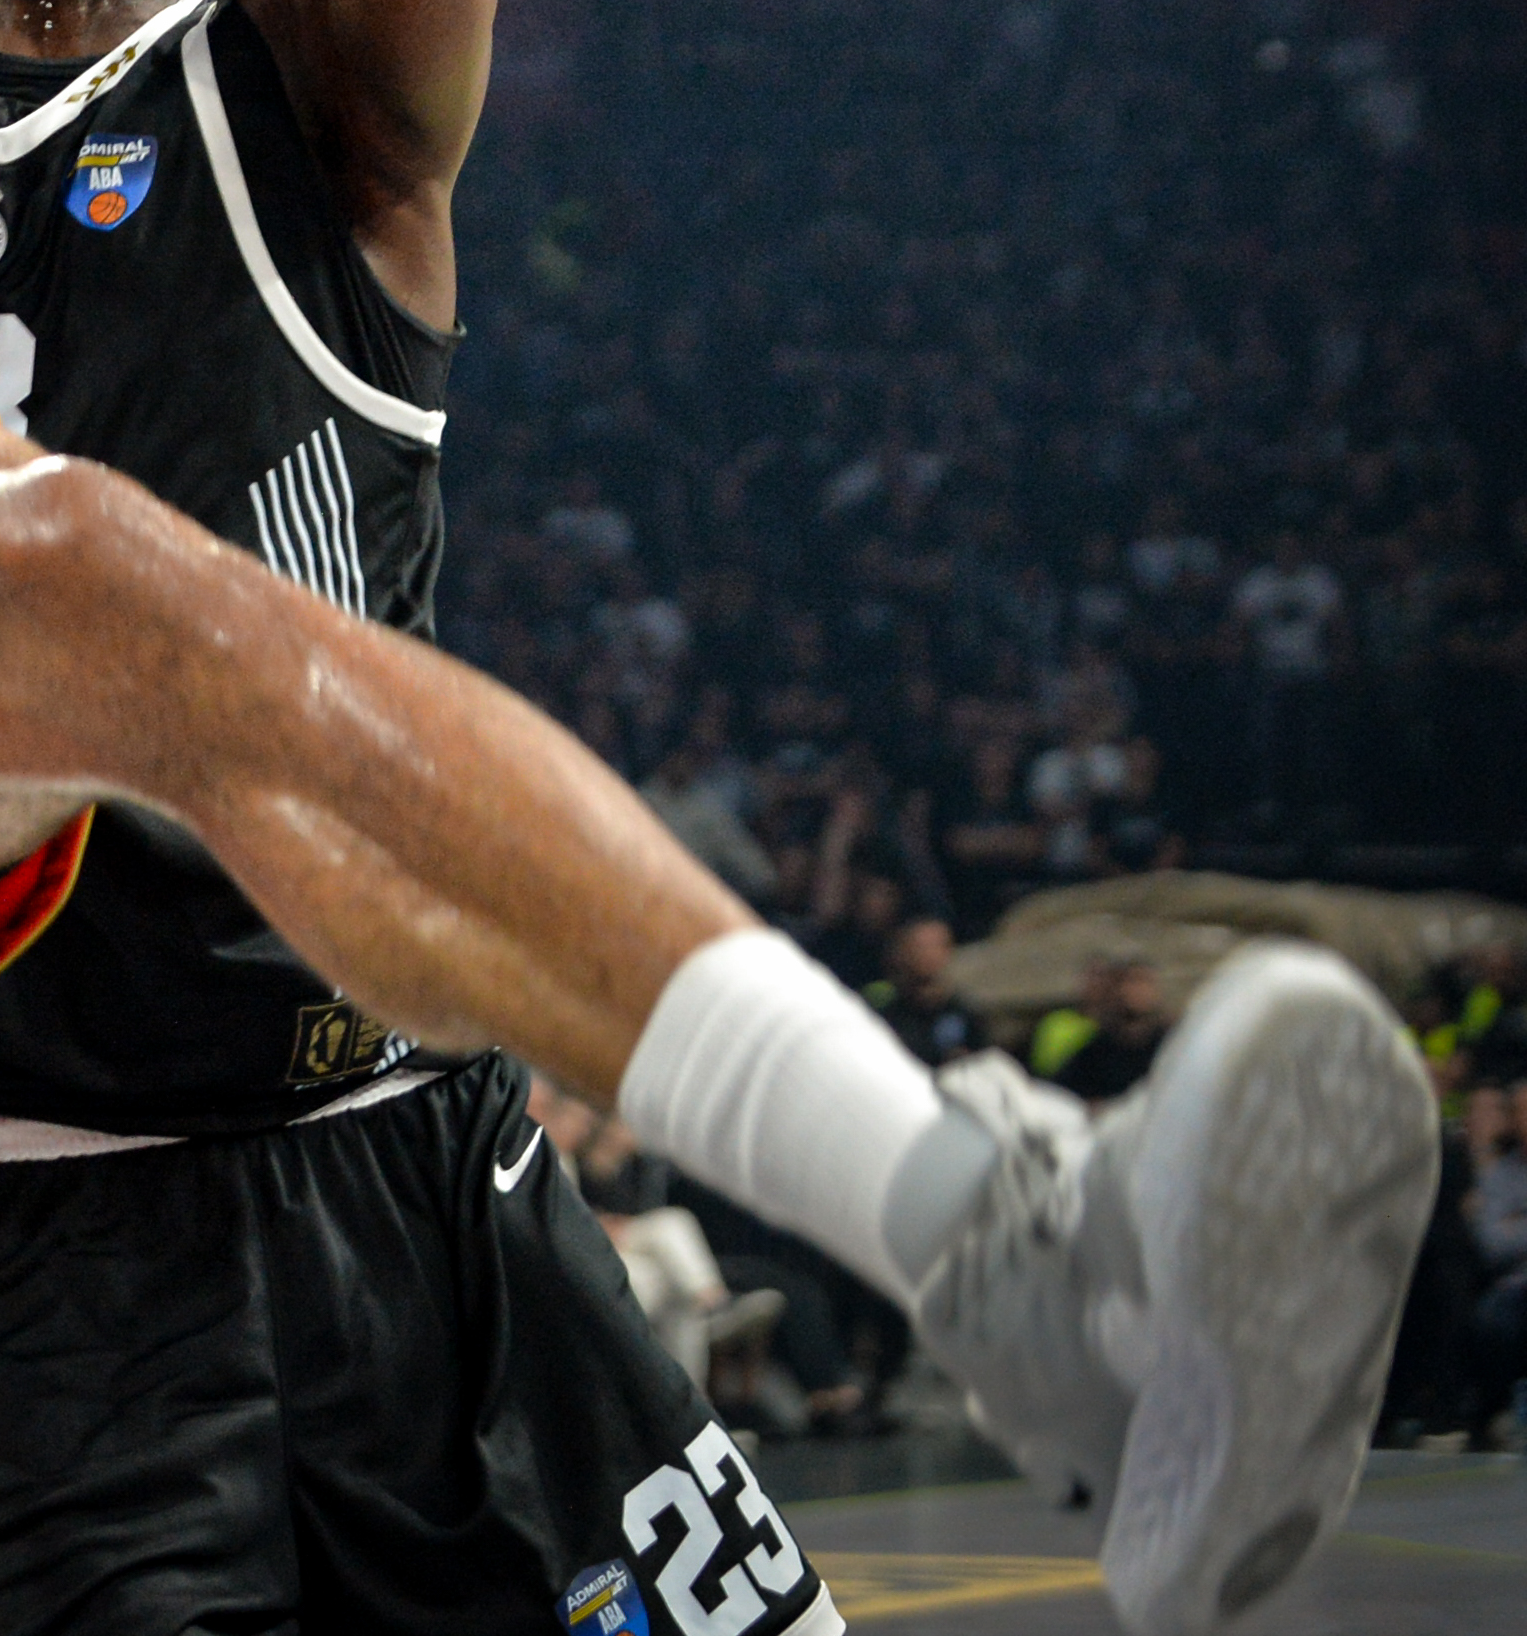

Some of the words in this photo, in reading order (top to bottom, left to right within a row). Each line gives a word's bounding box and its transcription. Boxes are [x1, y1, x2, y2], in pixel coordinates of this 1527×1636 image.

[79, 138, 151, 157] DMIRAL
[89, 165, 124, 191] ABA
[621, 1419, 805, 1636] 23
[566, 1564, 626, 1613] ADMIRAL
[597, 1600, 627, 1636] ABA
